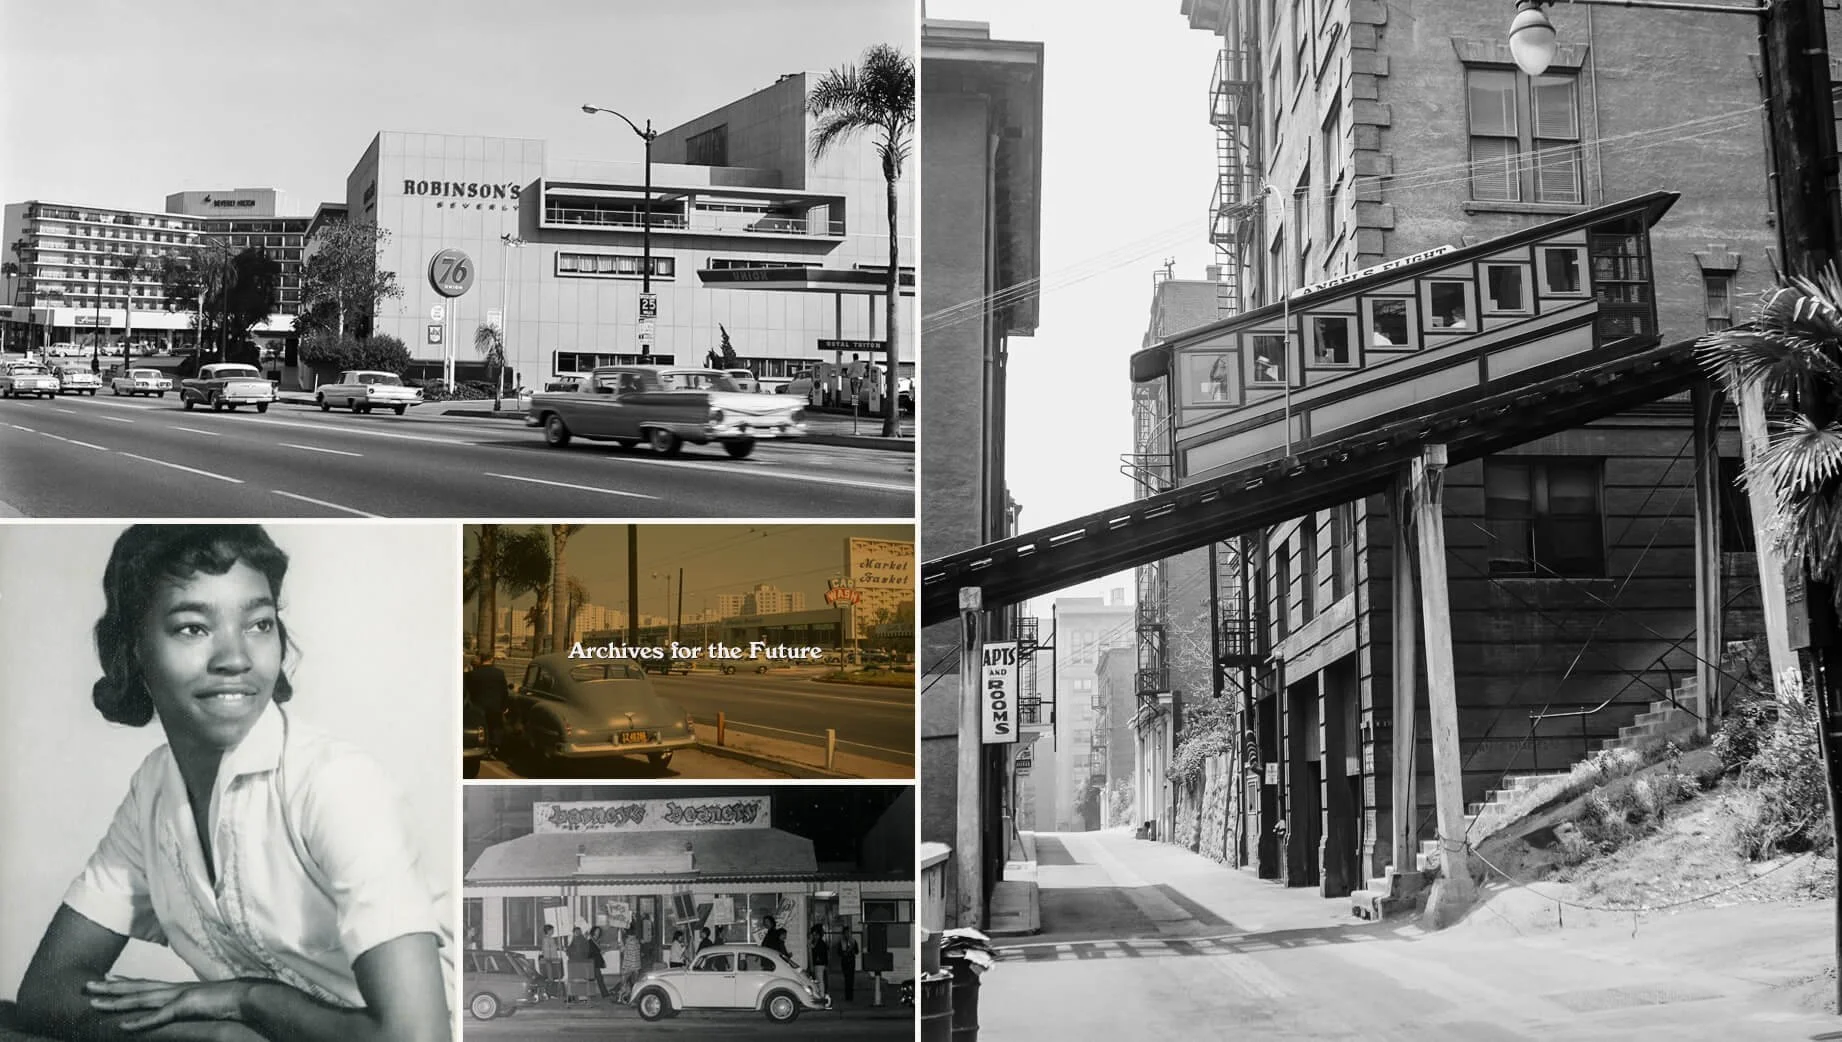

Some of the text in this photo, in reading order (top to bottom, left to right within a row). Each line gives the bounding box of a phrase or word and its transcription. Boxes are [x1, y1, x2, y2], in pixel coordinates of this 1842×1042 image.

[403, 180, 520, 200] ROBINSON'S
[439, 256, 468, 284] 76
[642, 299, 656, 310] 25
[859, 558, 909, 570] Market
[826, 587, 860, 605] WASH
[983, 647, 1016, 667] APTS
[989, 668, 1008, 676] AND
[988, 680, 1010, 735] ROOMS
